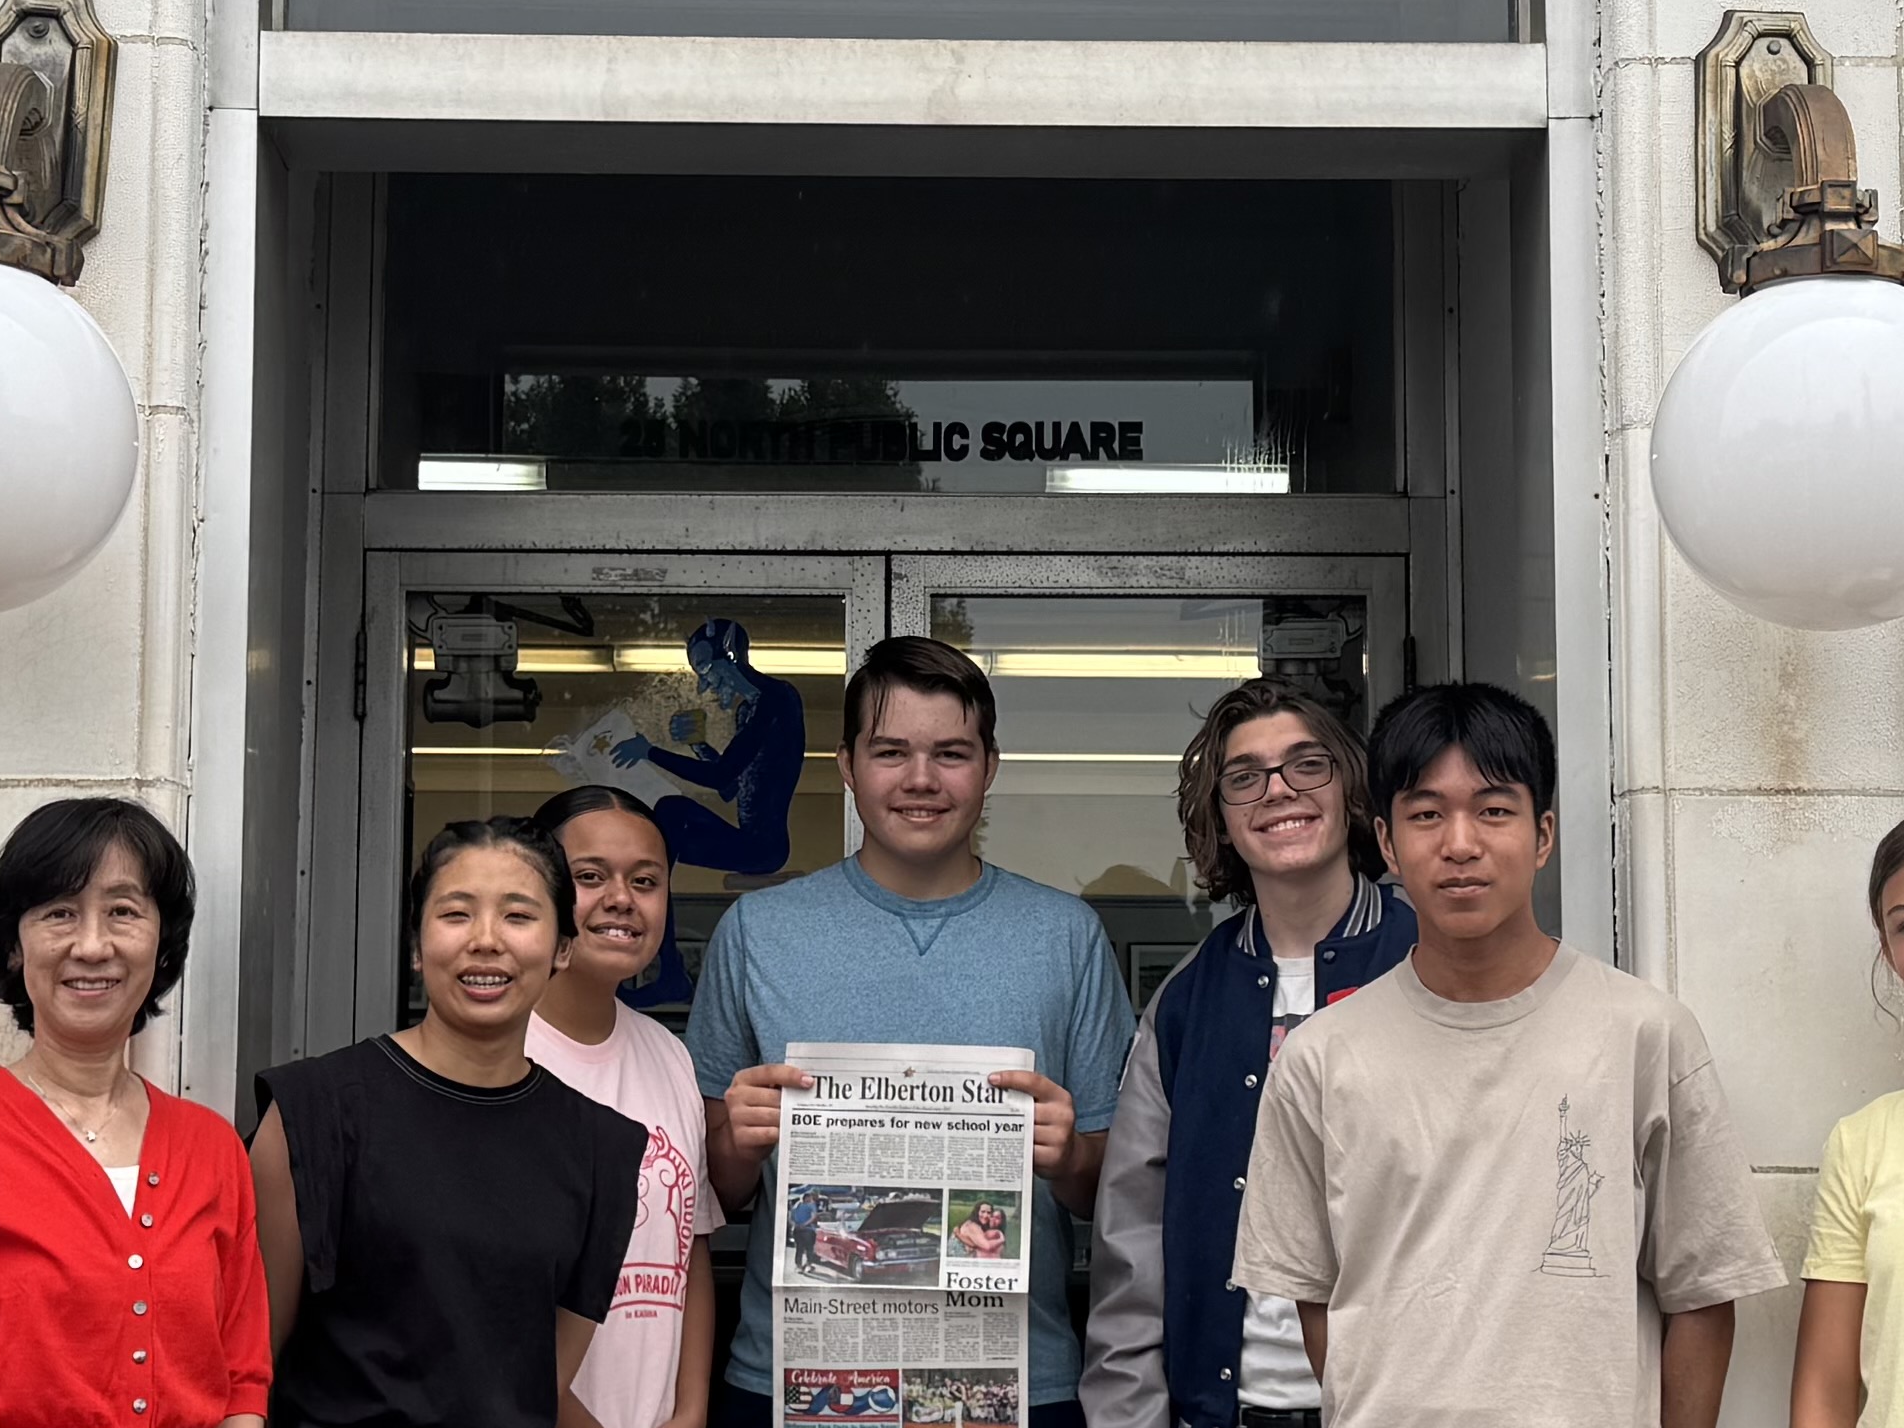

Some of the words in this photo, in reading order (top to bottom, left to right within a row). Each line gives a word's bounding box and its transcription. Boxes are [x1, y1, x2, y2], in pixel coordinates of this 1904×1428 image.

[831, 420, 969, 462] PUBLIC
[980, 420, 1144, 462] SQUARE
[812, 1075, 852, 1100] The
[859, 1076, 954, 1103] Elberton
[962, 1078, 1008, 1104] Star
[792, 1113, 822, 1126] BOE
[826, 1116, 885, 1130] prepares
[890, 1116, 910, 1129] for
[914, 1120, 943, 1130] new
[947, 1118, 990, 1132] school
[993, 1121, 1024, 1133] year
[946, 1272, 1018, 1290] Foster
[784, 1297, 877, 1315] Main-Street
[882, 1300, 939, 1314] motors
[944, 1291, 1004, 1308] Mom
[791, 1370, 837, 1385] Celebrate
[847, 1370, 890, 1385] America
